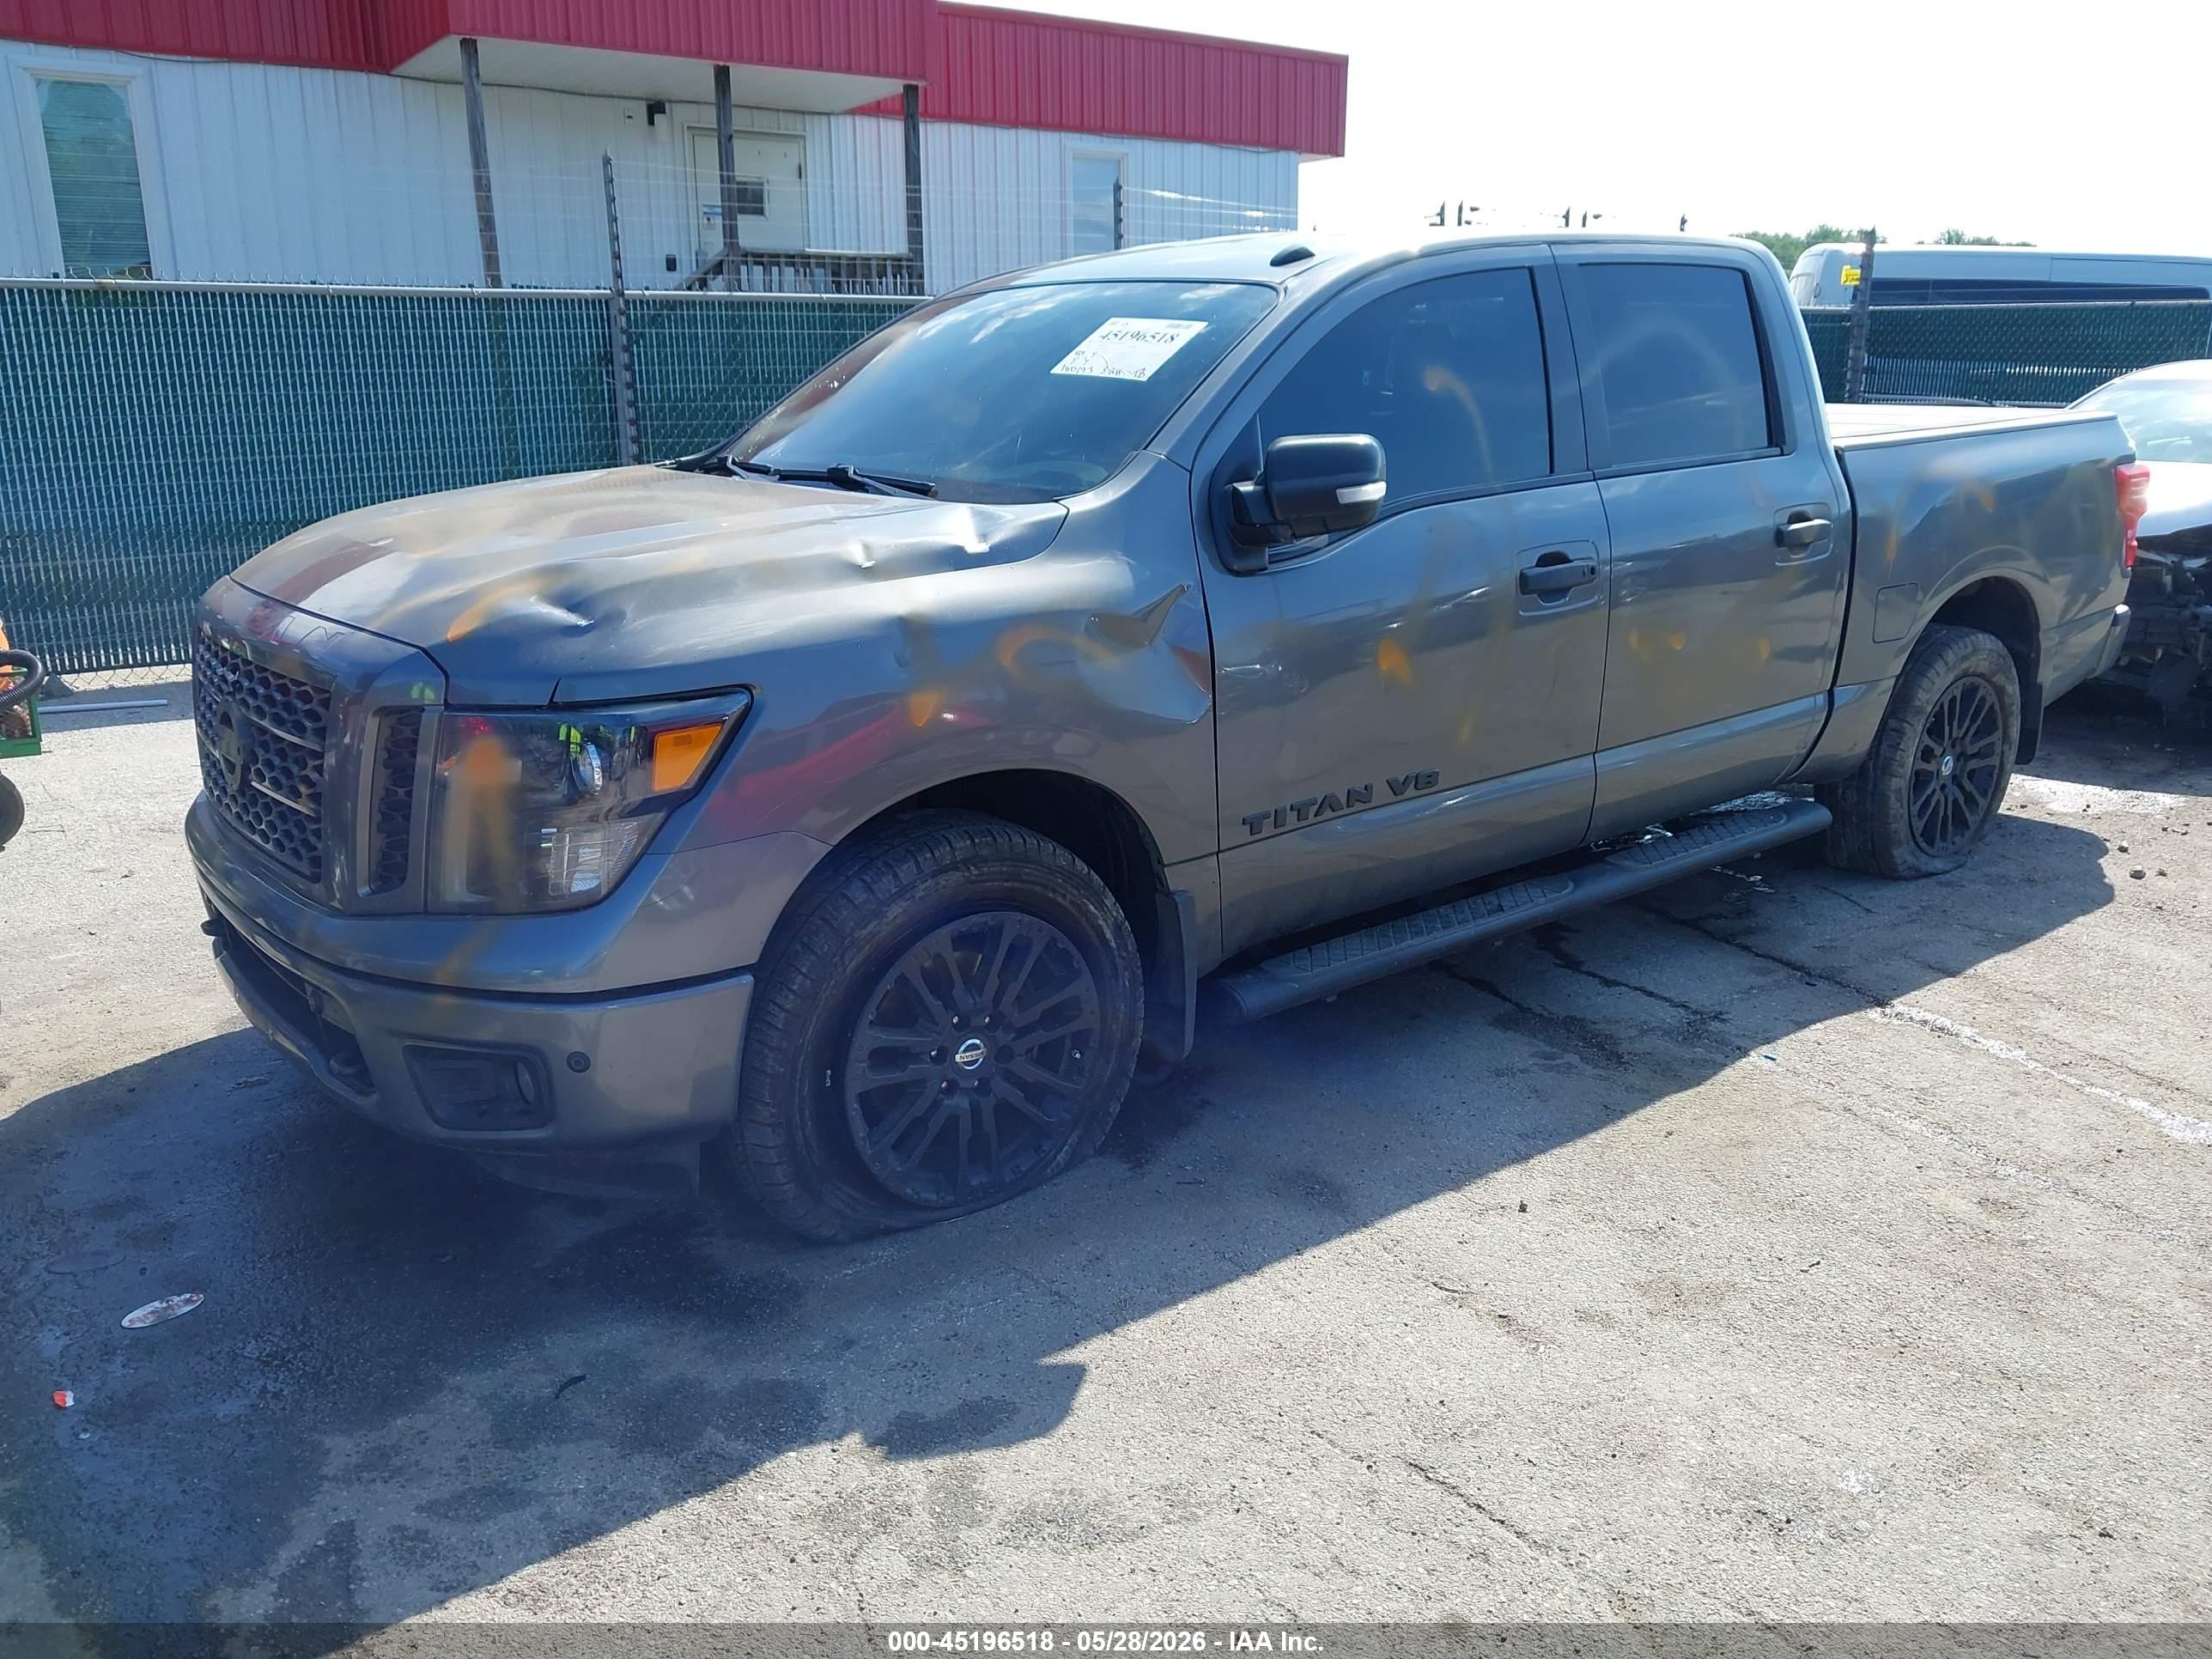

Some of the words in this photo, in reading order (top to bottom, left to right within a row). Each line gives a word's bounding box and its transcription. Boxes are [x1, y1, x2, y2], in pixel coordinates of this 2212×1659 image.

[1099, 330, 1181, 343] 45196518
[1242, 783, 1374, 836] TITAN
[1386, 769, 1440, 796] V8
